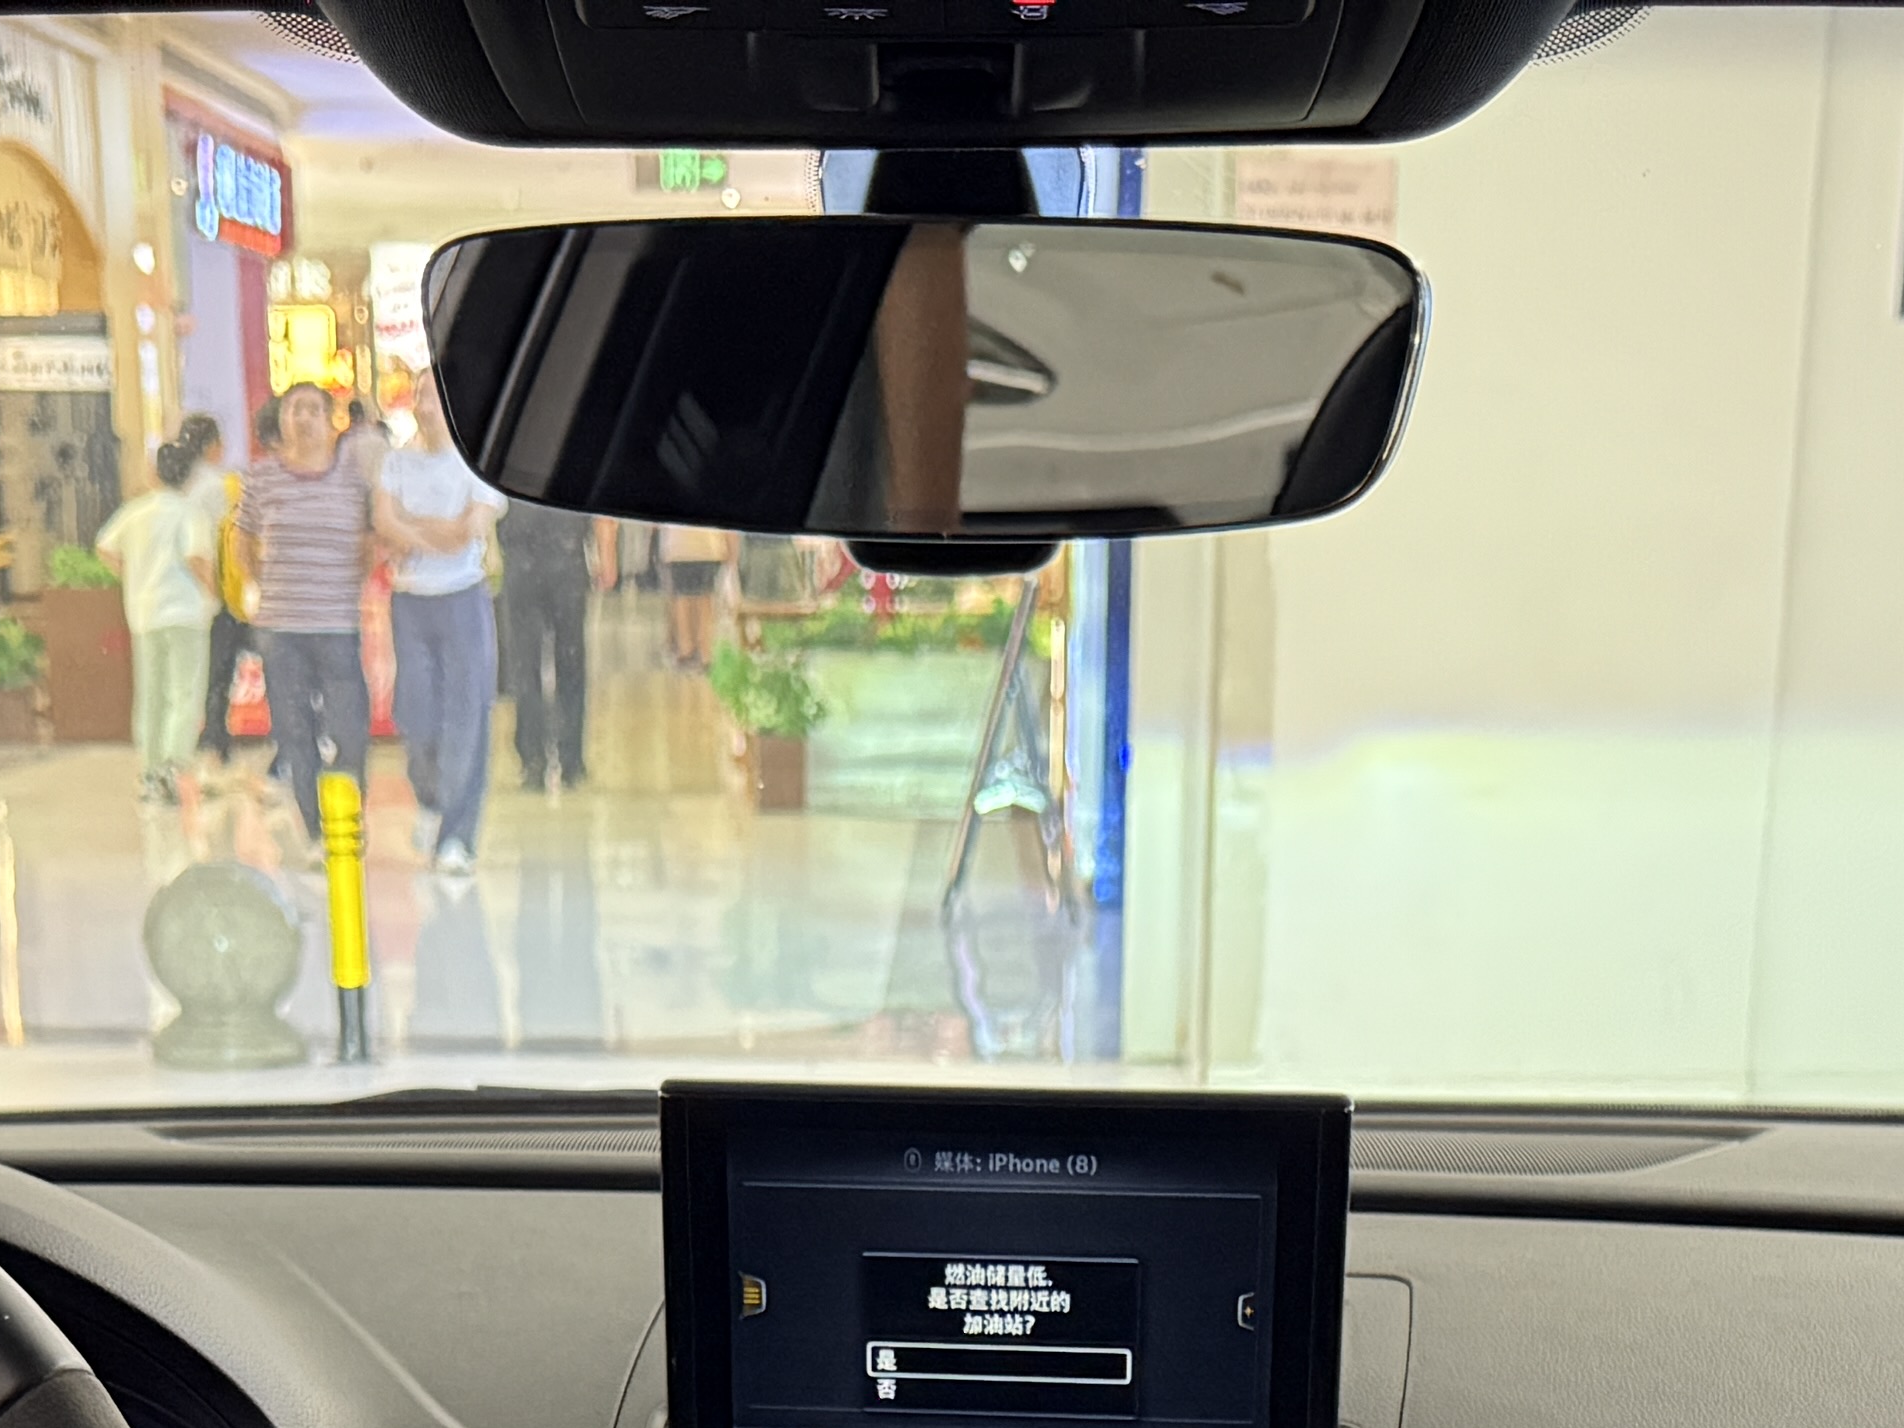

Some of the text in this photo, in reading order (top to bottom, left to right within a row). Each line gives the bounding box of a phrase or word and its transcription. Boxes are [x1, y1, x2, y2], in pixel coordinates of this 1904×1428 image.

[988, 1153, 1060, 1175] iPhone
[1066, 1154, 1098, 1177] (8)
[927, 1287, 1071, 1313] 是否查找附近的
[876, 1350, 897, 1373] 是
[876, 1379, 897, 1401] 否
